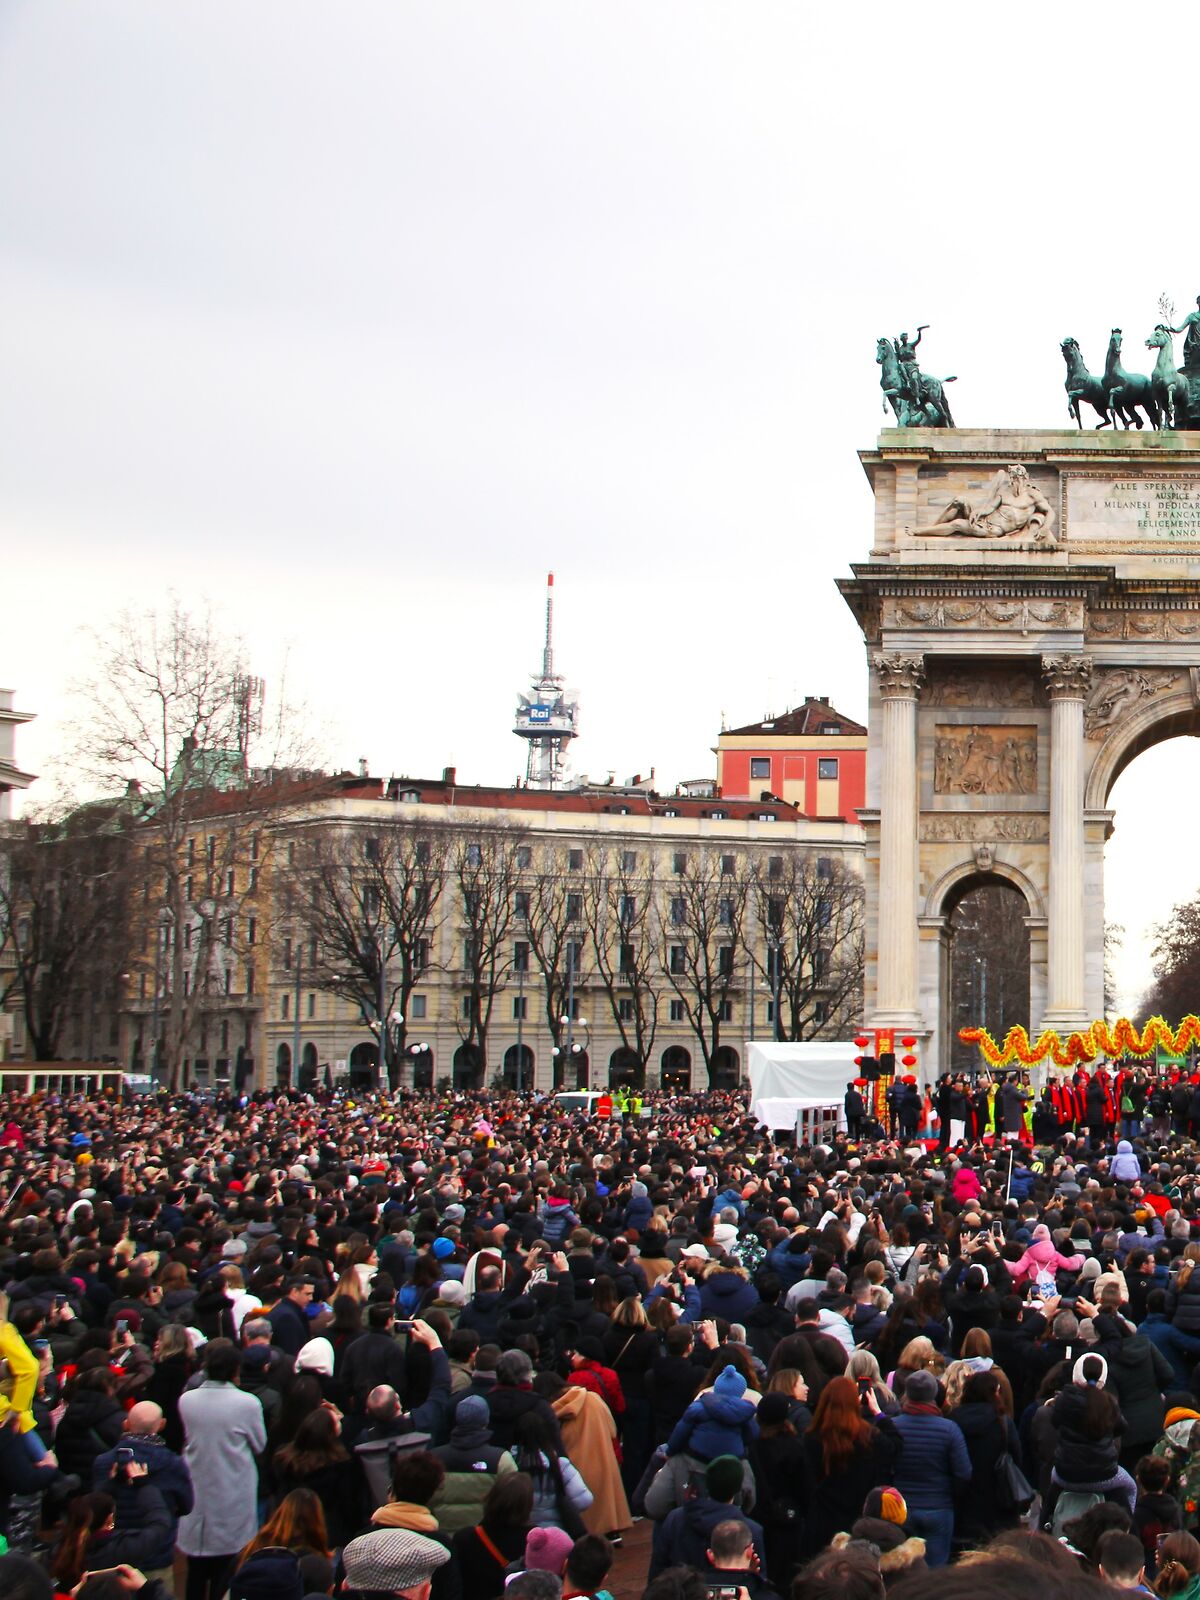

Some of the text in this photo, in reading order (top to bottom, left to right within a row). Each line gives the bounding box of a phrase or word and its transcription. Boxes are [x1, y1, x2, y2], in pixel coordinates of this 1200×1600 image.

[1113, 483, 1137, 491] ALLE
[1144, 483, 1194, 491] SPERANZE
[1155, 492, 1190, 500] AUSPICE
[1104, 501, 1151, 509] MILANESI
[1169, 529, 1197, 537] ANNO
[531, 708, 549, 718] Rai
